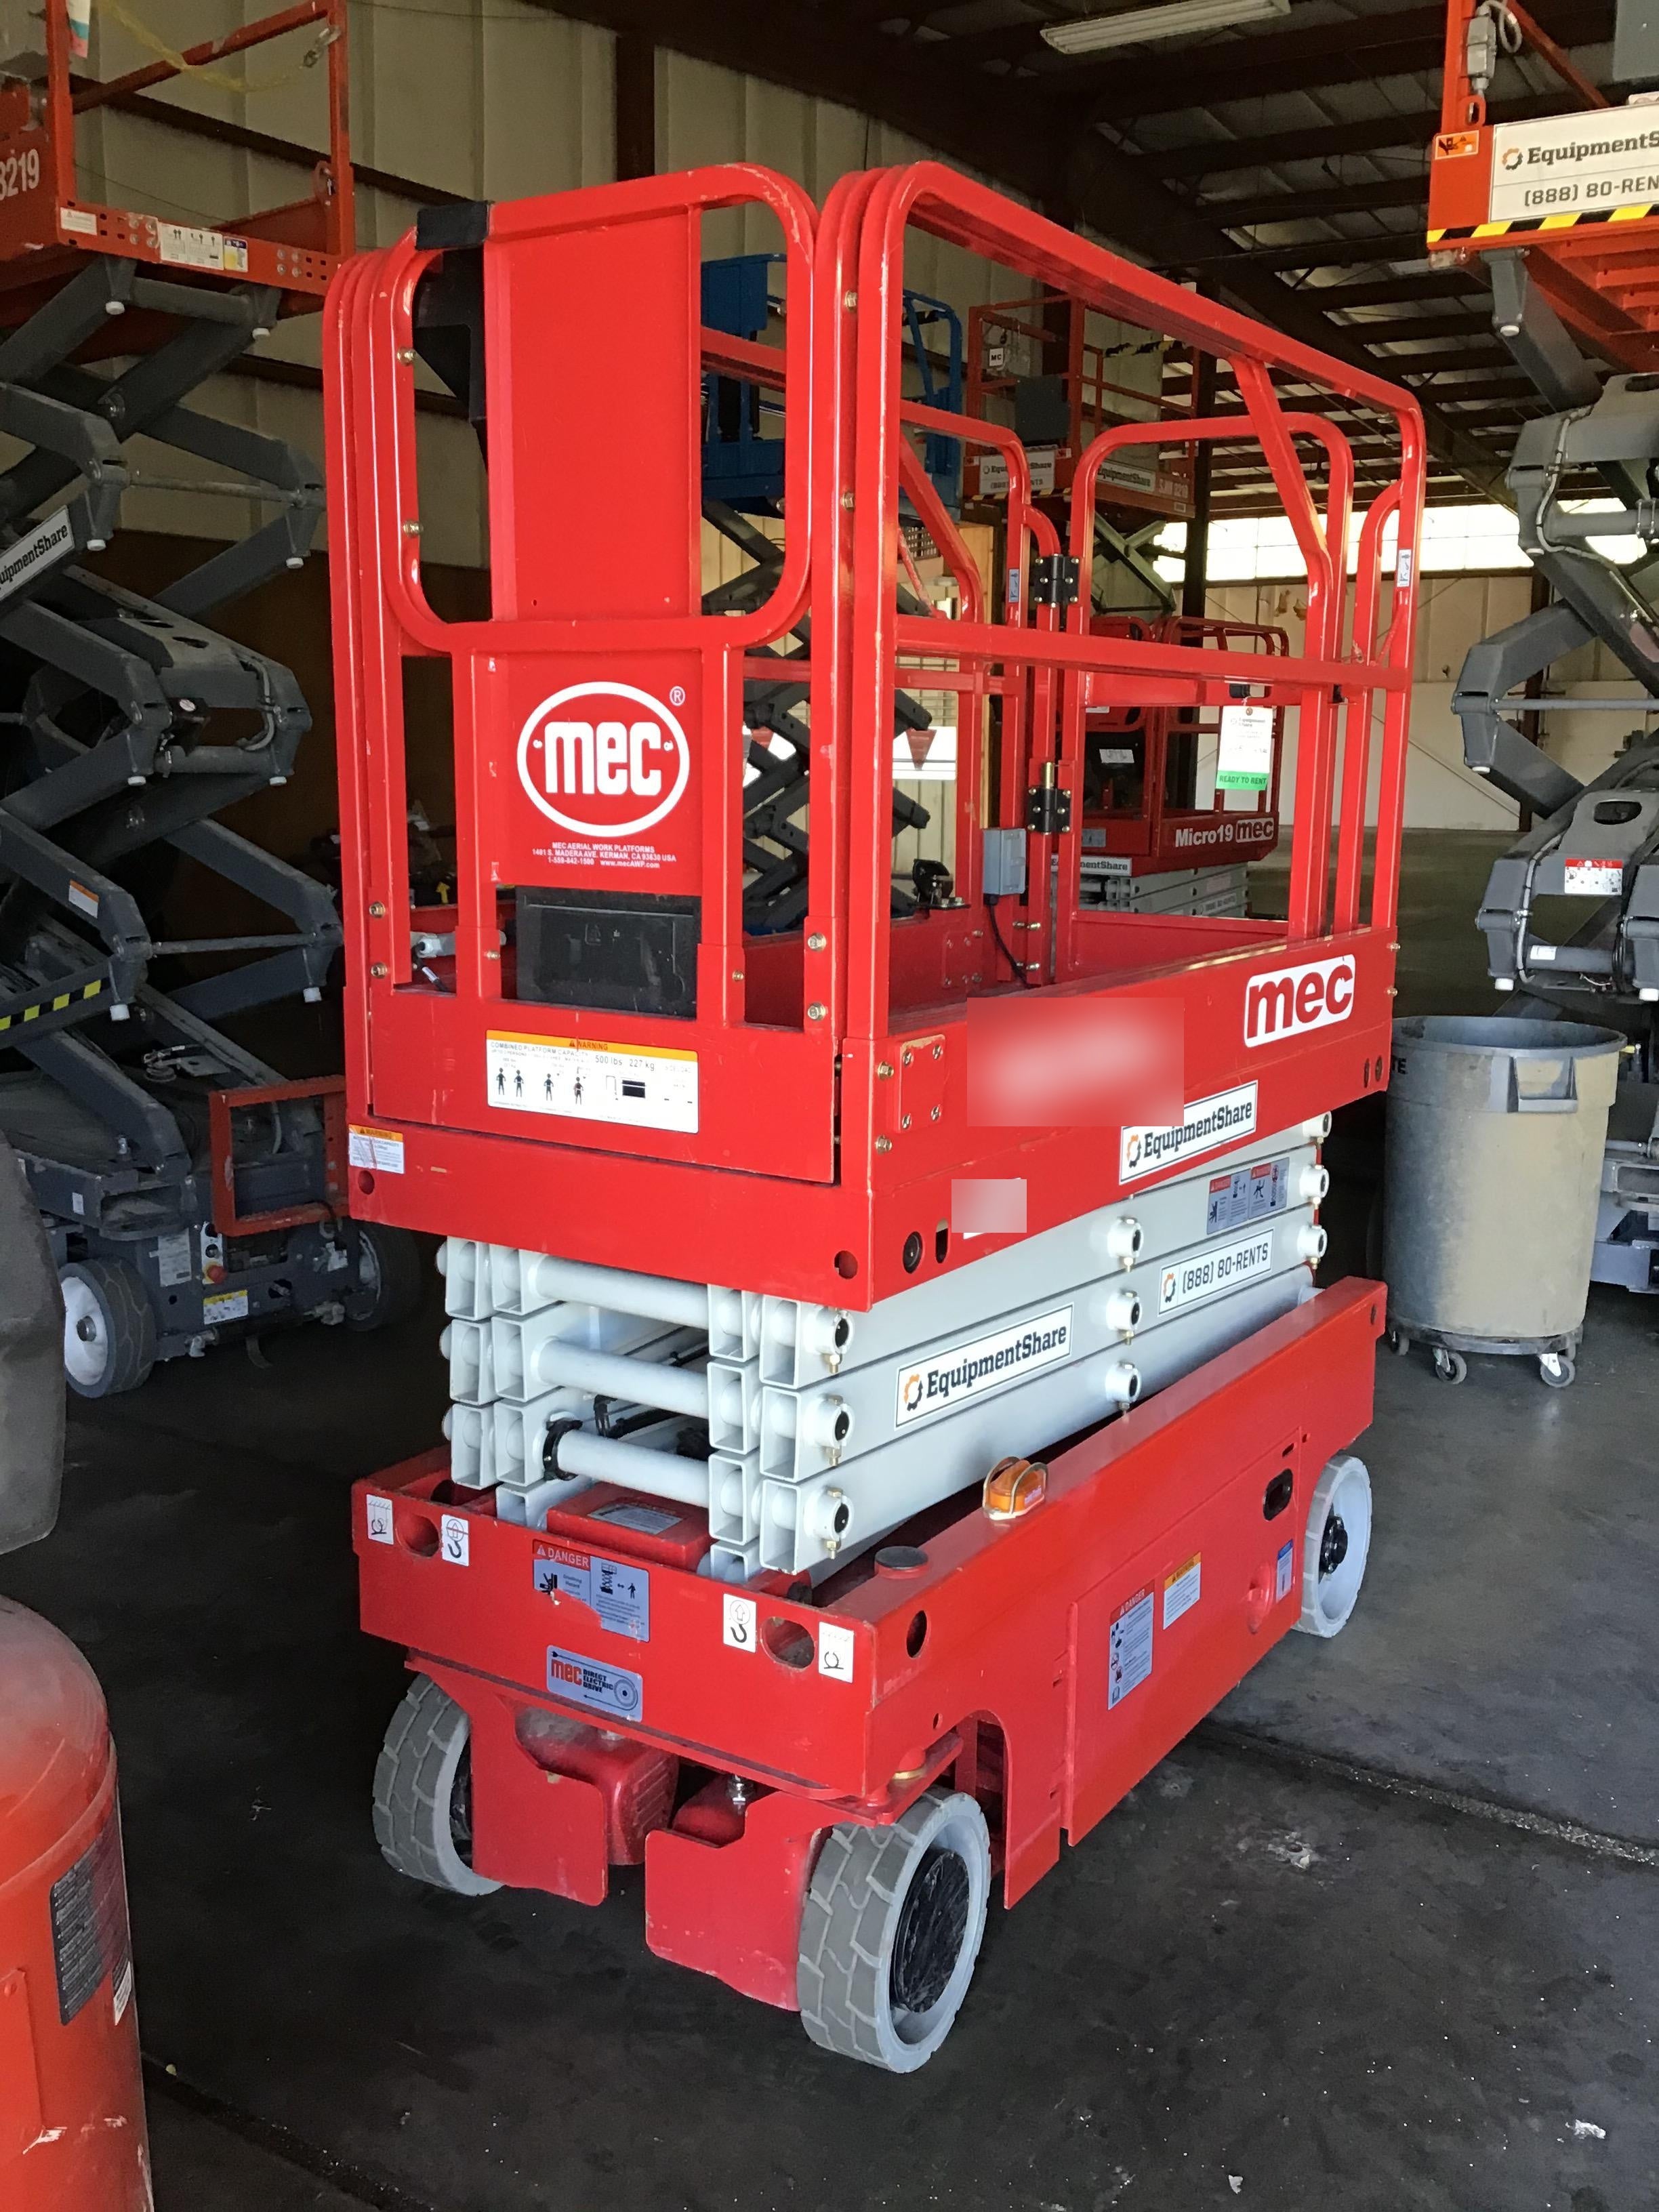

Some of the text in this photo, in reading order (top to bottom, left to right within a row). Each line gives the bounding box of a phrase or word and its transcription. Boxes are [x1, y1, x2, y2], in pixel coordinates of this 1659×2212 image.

[1525, 184, 1578, 206] (888)
[1220, 775, 1239, 783] READY
[1237, 821, 1273, 840] mec
[555, 849, 583, 857] MADERA
[600, 851, 630, 860] KERMAN,
[661, 854, 676, 862] USA
[592, 843, 613, 851] WORK
[614, 844, 655, 853] PLATFORMS
[1247, 964, 1353, 1039] mec
[491, 1042, 523, 1050] COMBINED
[524, 1045, 556, 1054] PLATFORM
[578, 1041, 608, 1050] WARNING
[595, 1054, 609, 1064] 500
[611, 1055, 622, 1065] lbs
[630, 1059, 642, 1067] 227
[645, 1061, 655, 1071] kg
[1144, 1102, 1252, 1159] EquipmentShare
[1183, 1242, 1269, 1294] (888) 80-RENTS
[926, 1326, 1067, 1398] EquipmentShare
[548, 1547, 590, 1568] DANGER
[551, 1658, 582, 1686] mec
[583, 1668, 607, 1681] DIRECT
[583, 1675, 613, 1690] ELECTRIC
[583, 1682, 602, 1693] DRIVE
